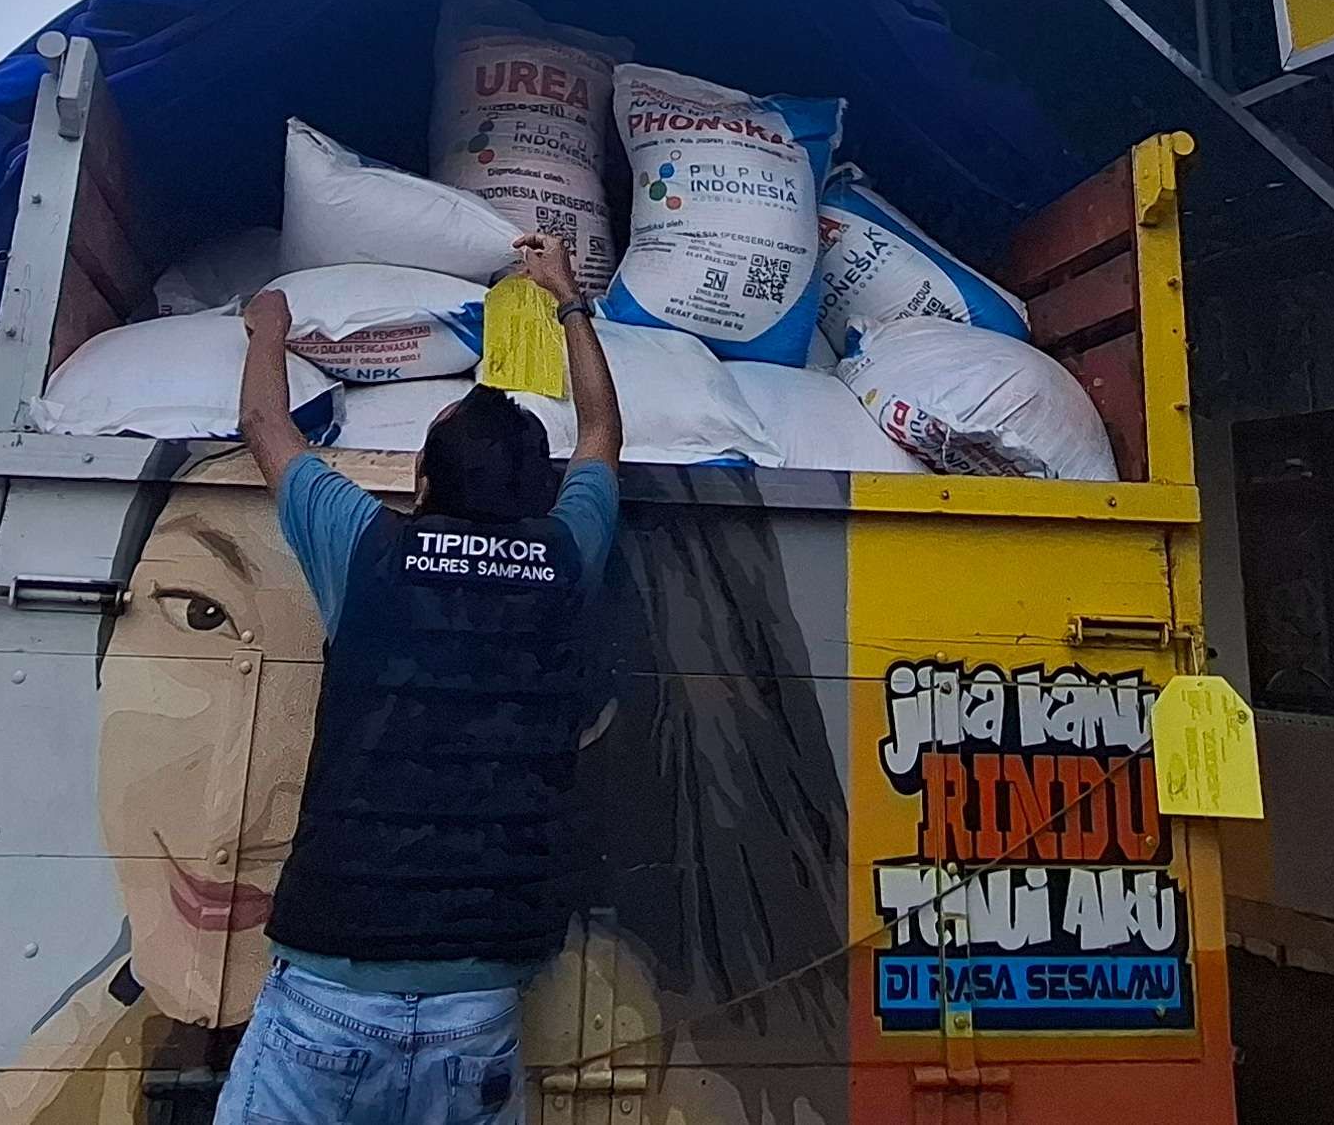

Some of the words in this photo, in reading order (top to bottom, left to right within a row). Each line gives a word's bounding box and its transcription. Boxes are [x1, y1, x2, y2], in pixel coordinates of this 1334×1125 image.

[475, 61, 589, 111] UREA
[690, 164, 796, 189] PUPUK
[691, 180, 798, 205] INDONESIA
[354, 341, 419, 354] PENGAWASAN
[356, 367, 401, 379] NPK
[417, 532, 548, 563] TIPIDKOR
[405, 555, 470, 574] POLRES
[477, 561, 556, 582] SAMPANG
[884, 666, 1004, 774] jika
[922, 753, 1160, 861] RINDU
[885, 964, 918, 1000] DI
[927, 964, 1017, 1001] RASA
[1025, 964, 1175, 1000] SESALMU
